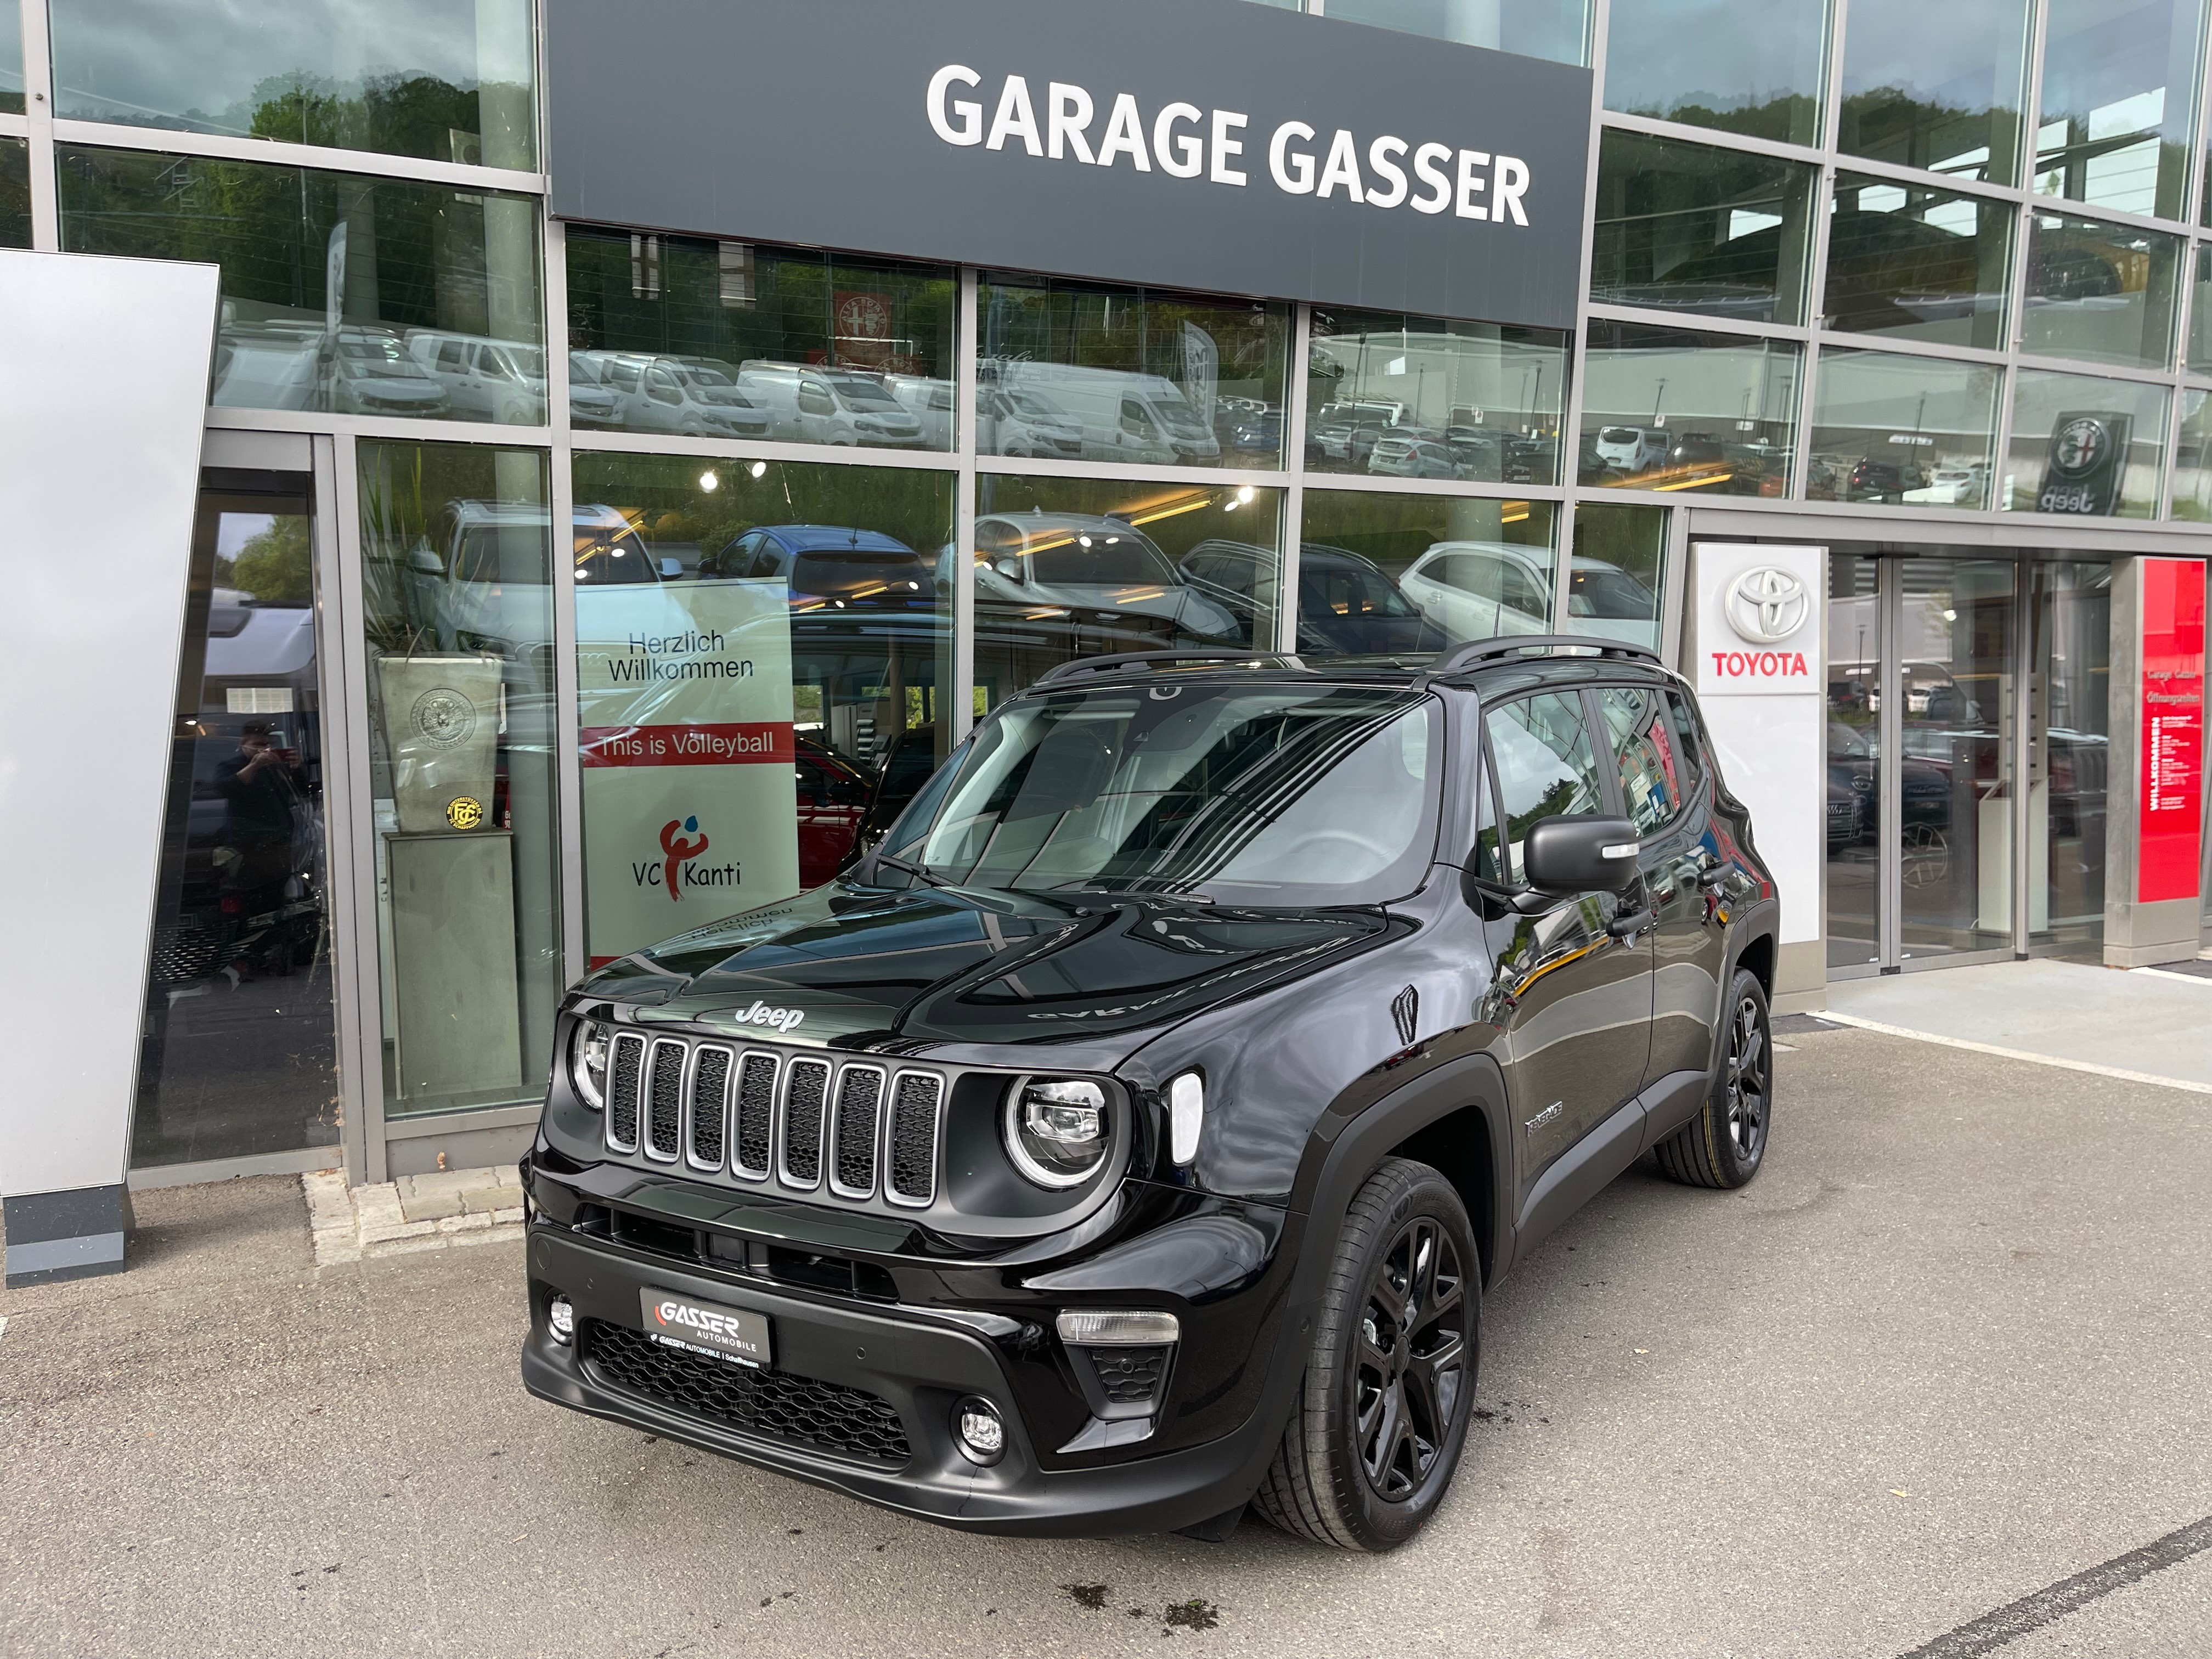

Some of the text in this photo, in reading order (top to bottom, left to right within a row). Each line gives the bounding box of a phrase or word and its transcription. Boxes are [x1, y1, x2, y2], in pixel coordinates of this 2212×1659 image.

[927, 64, 1530, 227] GARAGE GASSER
[841, 298, 886, 324] ALFA ROMEO
[1413, 341, 1446, 349] www.garag
[629, 629, 725, 654] Herzlich
[608, 658, 753, 682] Willkommen
[1712, 652, 1808, 676] TOYOTA
[598, 731, 773, 758] This is Volleyball
[2149, 716, 2160, 811] WILLKOMMEN
[633, 862, 741, 887] VC Kanti
[735, 1000, 805, 1034] Jeep
[660, 1302, 740, 1338] GASSER
[659, 1335, 686, 1349] GASSER
[686, 1344, 720, 1358] AUTOMOBILE
[725, 1354, 759, 1369] Schaffhausen
[696, 1330, 757, 1353] AUTOMOBILE
